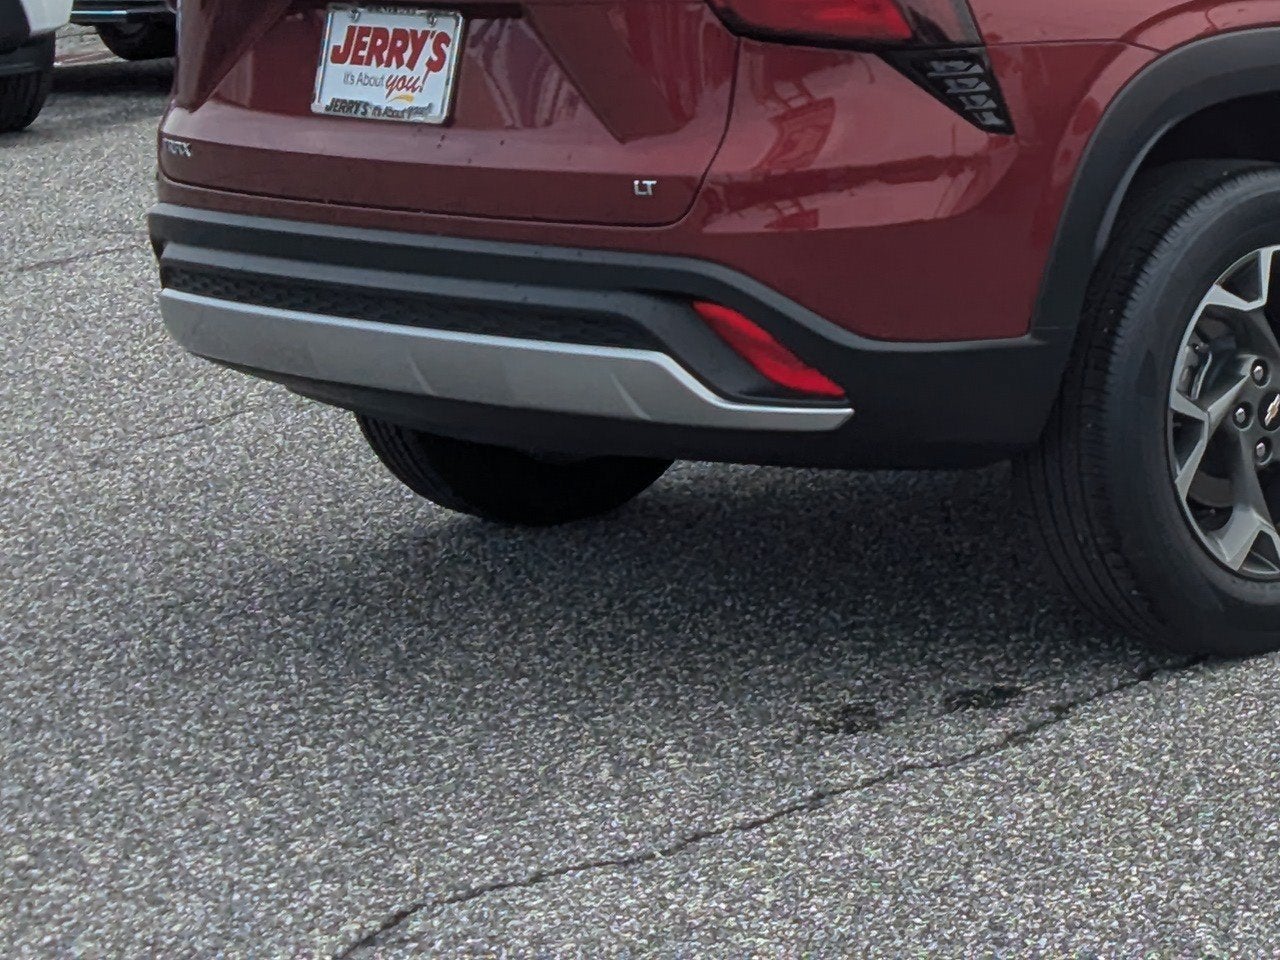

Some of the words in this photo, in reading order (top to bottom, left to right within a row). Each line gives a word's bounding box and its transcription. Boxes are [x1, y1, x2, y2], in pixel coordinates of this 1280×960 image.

[330, 24, 451, 73] JERRY'S
[356, 72, 385, 88] About
[385, 70, 430, 100] you!
[325, 97, 370, 117] JERRY'S
[633, 180, 657, 195] LT
